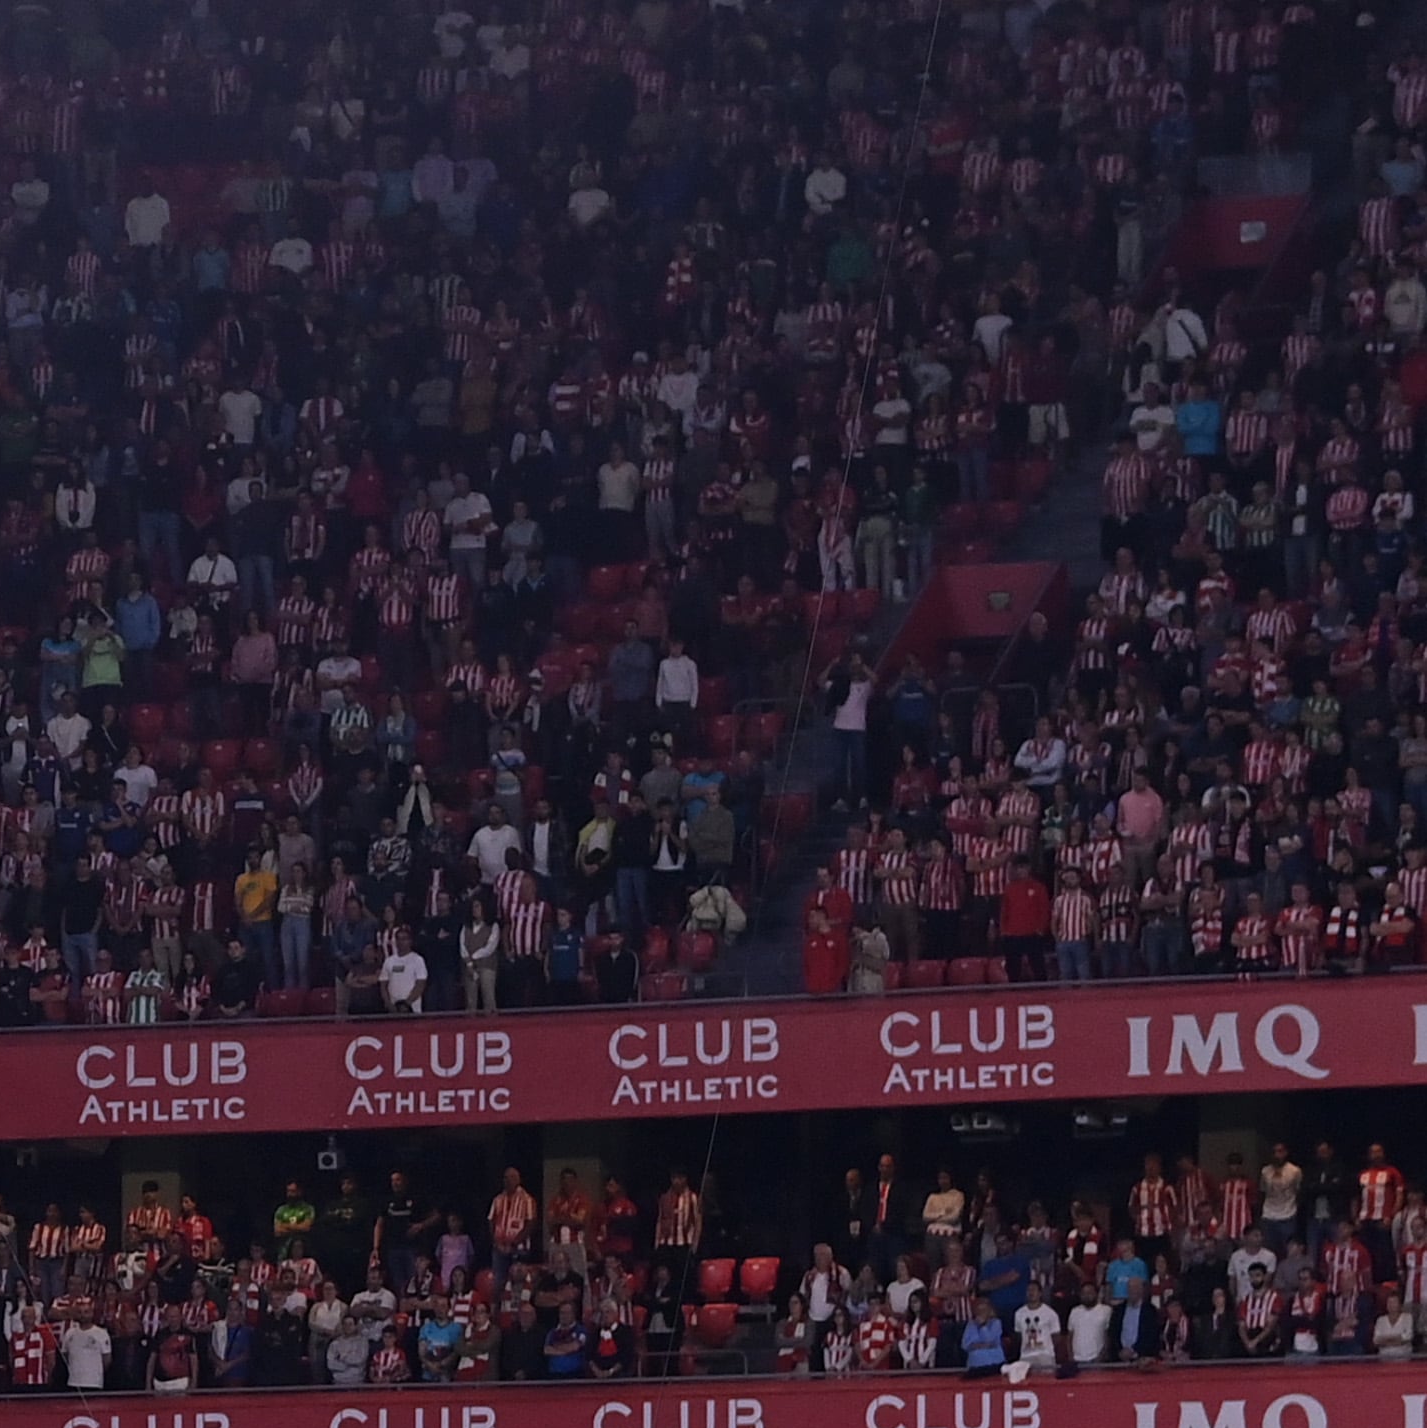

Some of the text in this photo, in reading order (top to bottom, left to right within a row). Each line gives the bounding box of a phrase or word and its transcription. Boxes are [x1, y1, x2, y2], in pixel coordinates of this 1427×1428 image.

[345, 1031, 512, 1080] CLUB
[608, 1018, 779, 1069] CLUB
[880, 1005, 1055, 1057] CLUB
[1127, 1004, 1330, 1079] IMQ
[76, 1041, 247, 1089] CLUB
